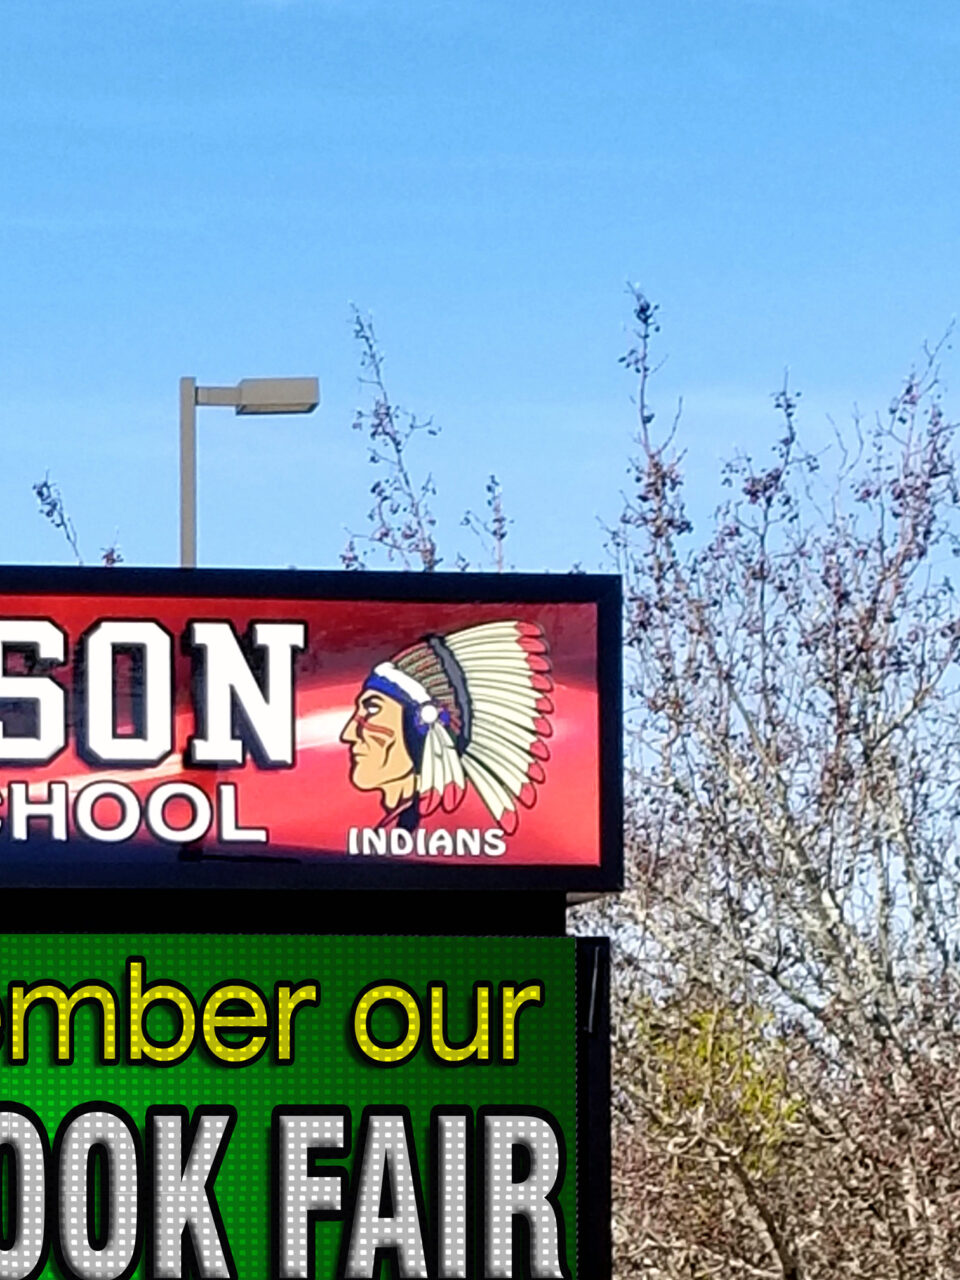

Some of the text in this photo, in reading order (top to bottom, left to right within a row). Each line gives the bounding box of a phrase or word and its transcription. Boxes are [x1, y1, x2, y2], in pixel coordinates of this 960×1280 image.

[348, 827, 507, 856] INDIANS
[352, 982, 542, 1064] our
[270, 1113, 571, 1280] FAIR
